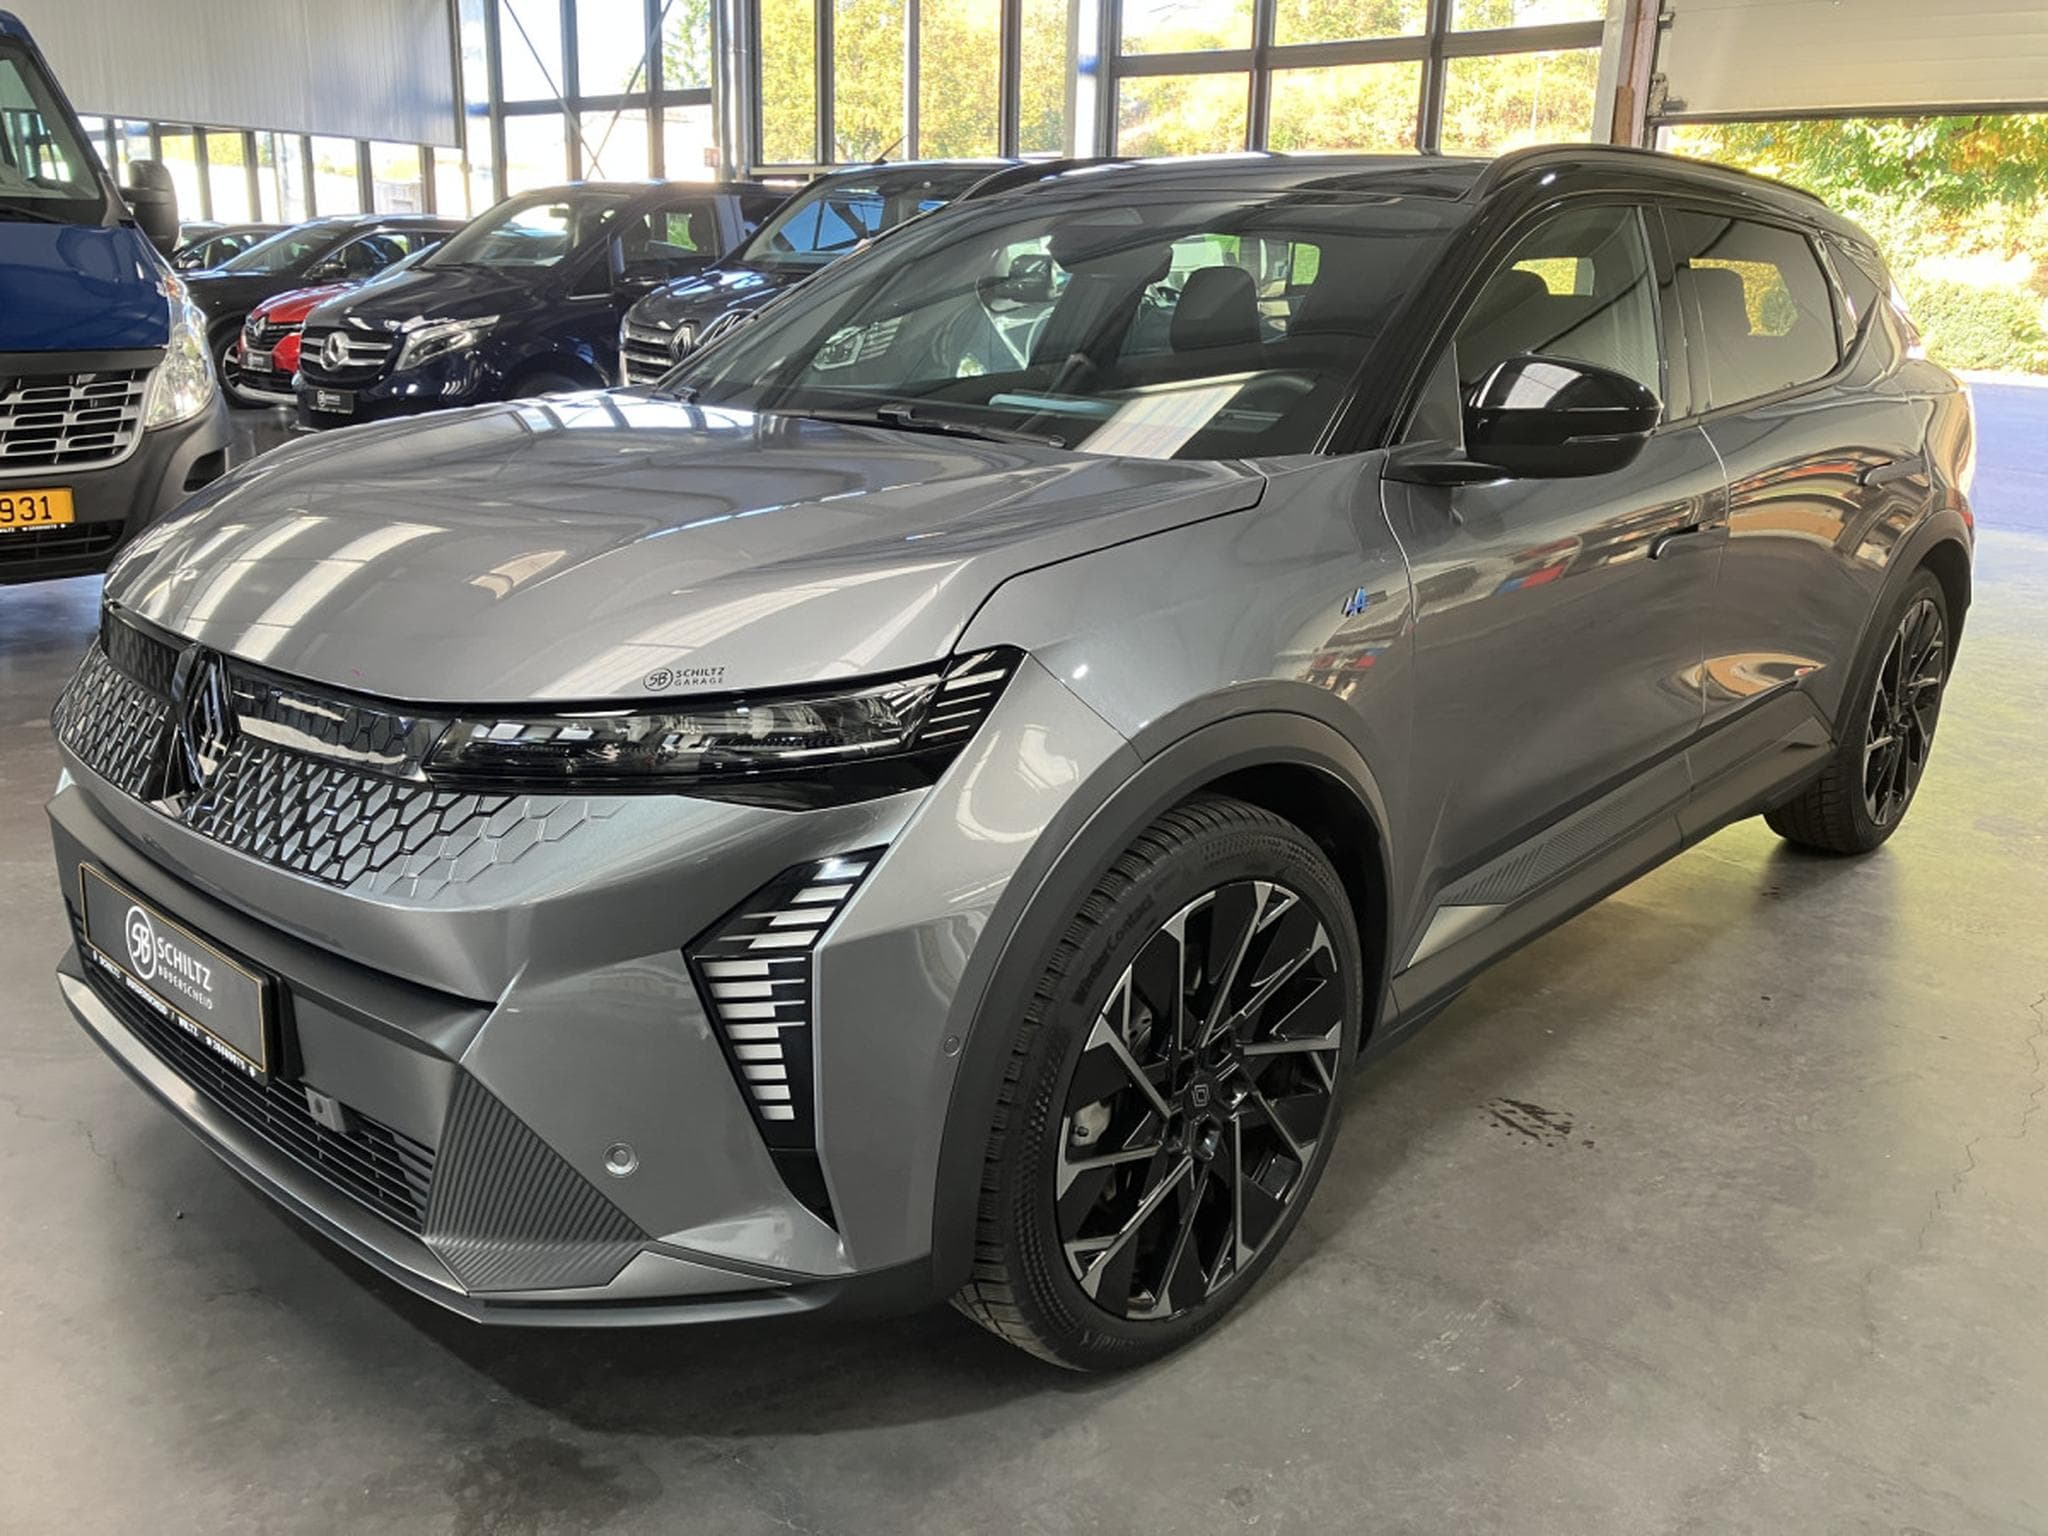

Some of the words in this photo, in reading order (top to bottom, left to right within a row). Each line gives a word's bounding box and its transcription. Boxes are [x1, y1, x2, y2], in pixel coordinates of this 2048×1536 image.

[0, 496, 52, 523] 931
[674, 677, 723, 686] GARAGE
[675, 667, 725, 679] SCHILTZ
[131, 922, 151, 964] SB
[157, 936, 213, 992] SCHILTZ
